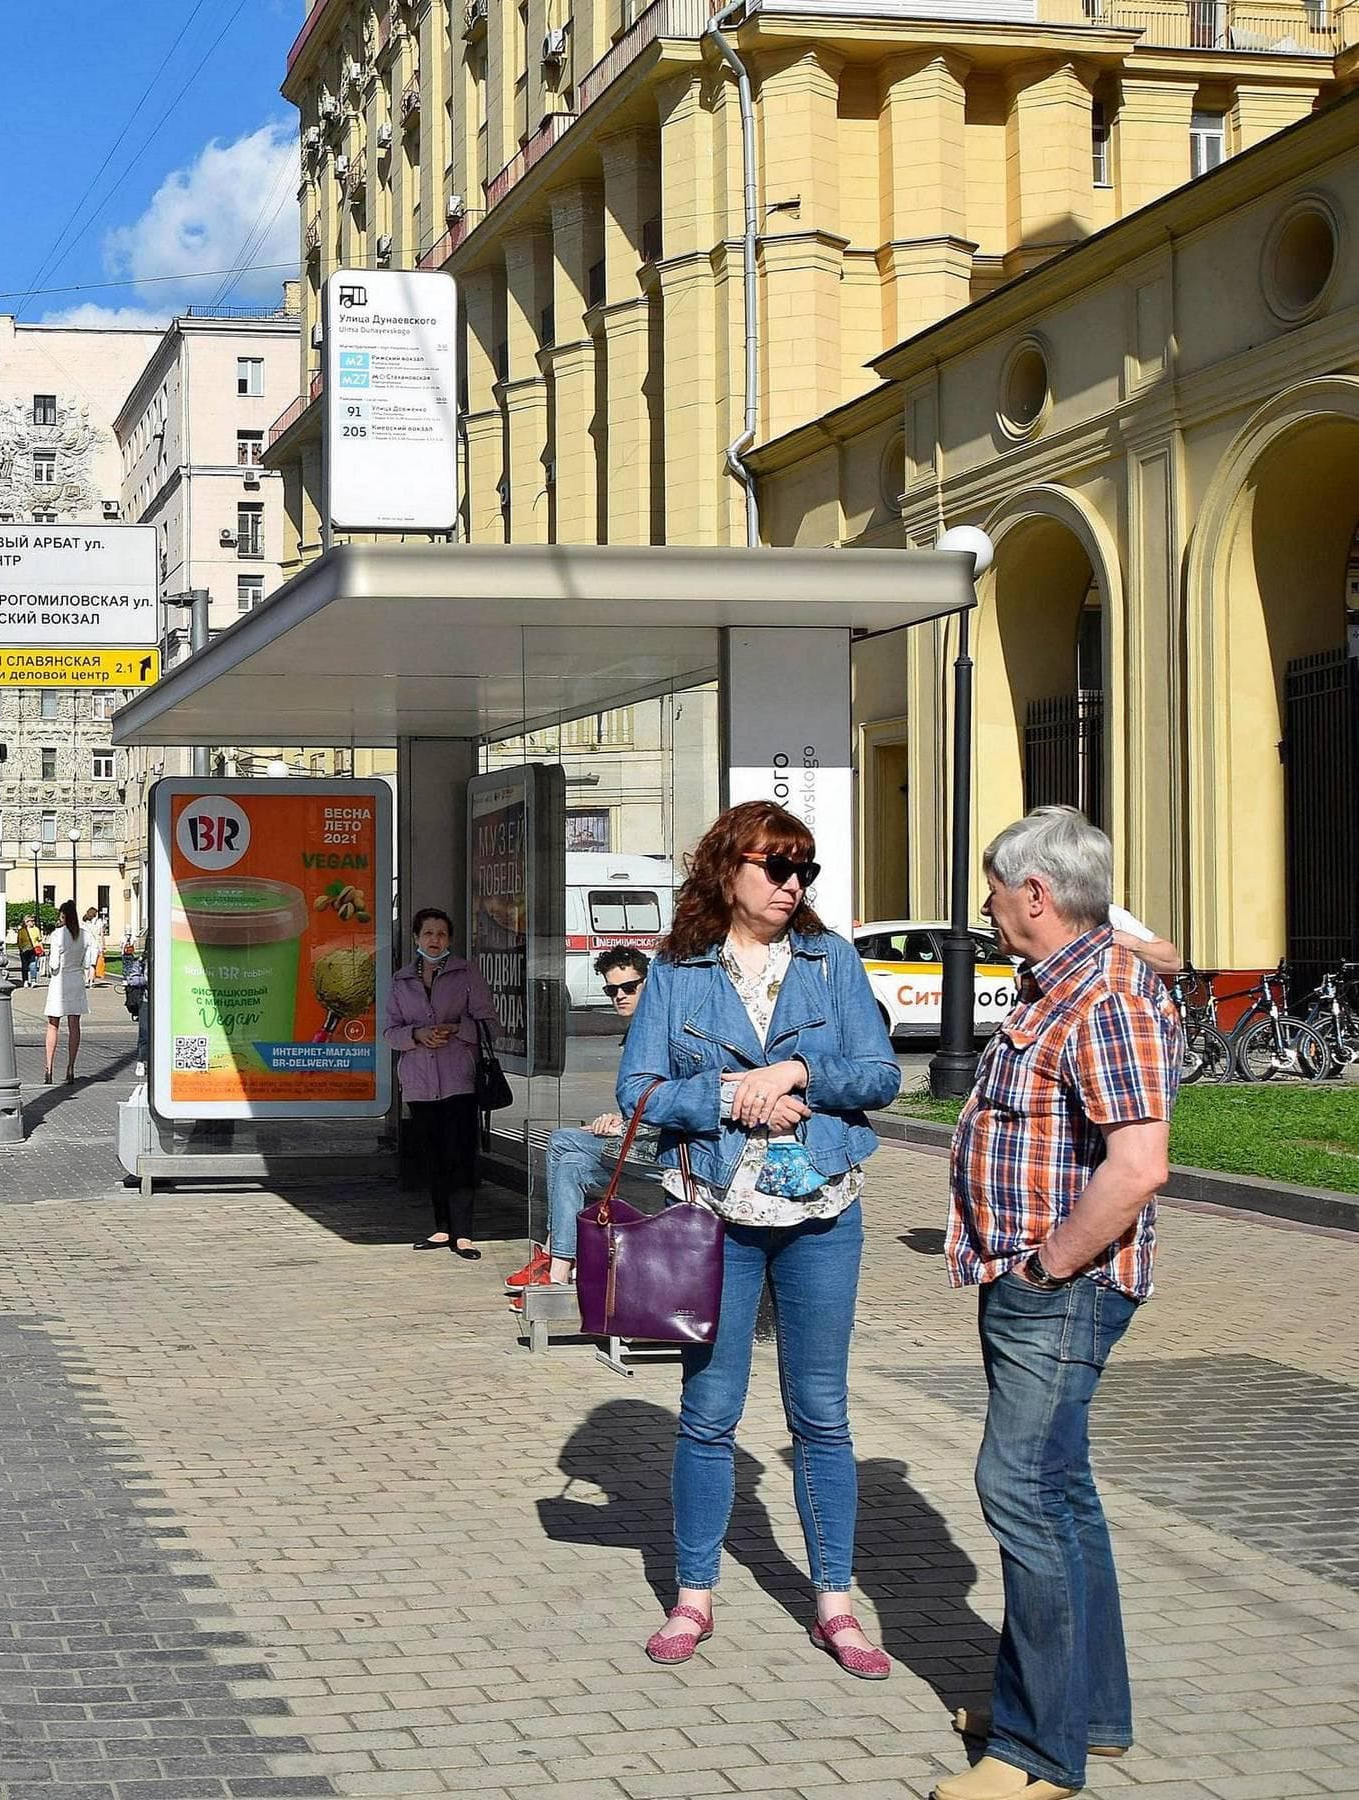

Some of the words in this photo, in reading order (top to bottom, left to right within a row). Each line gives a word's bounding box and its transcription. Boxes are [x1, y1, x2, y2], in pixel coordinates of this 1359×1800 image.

[339, 314, 370, 325] Улица
[372, 314, 437, 326] Дунаевского
[347, 406, 362, 418] 91
[343, 426, 367, 438] 205
[33, 537, 81, 550] АРБАТ
[85, 540, 105, 552] ул.
[133, 597, 154, 610] ул.
[41, 613, 100, 625] ВОКЗАЛ
[7, 655, 101, 668] СЛАВЯНСКАЯ
[116, 662, 134, 675] 2.1
[9, 668, 68, 682] деловой
[71, 671, 110, 683] центр
[799, 745, 819, 833] evskogo
[324, 808, 371, 819] ВЕСНА
[324, 820, 362, 831] ЛЕТО
[188, 815, 241, 851] BR
[323, 833, 357, 844] 2021
[479, 813, 525, 857] МУЗЕЙ
[302, 852, 369, 870] VEGAN
[479, 861, 525, 897] ПОБЕДЫ
[479, 953, 525, 992] ПОДВИГ
[192, 985, 269, 997] ФИСТАШКОВЫЙ
[205, 998, 261, 1007] МИНДАЛЕМ
[199, 1007, 262, 1036] Vegan
[273, 1047, 371, 1058] ИНТЕРНЕТ-МАГАЗИН
